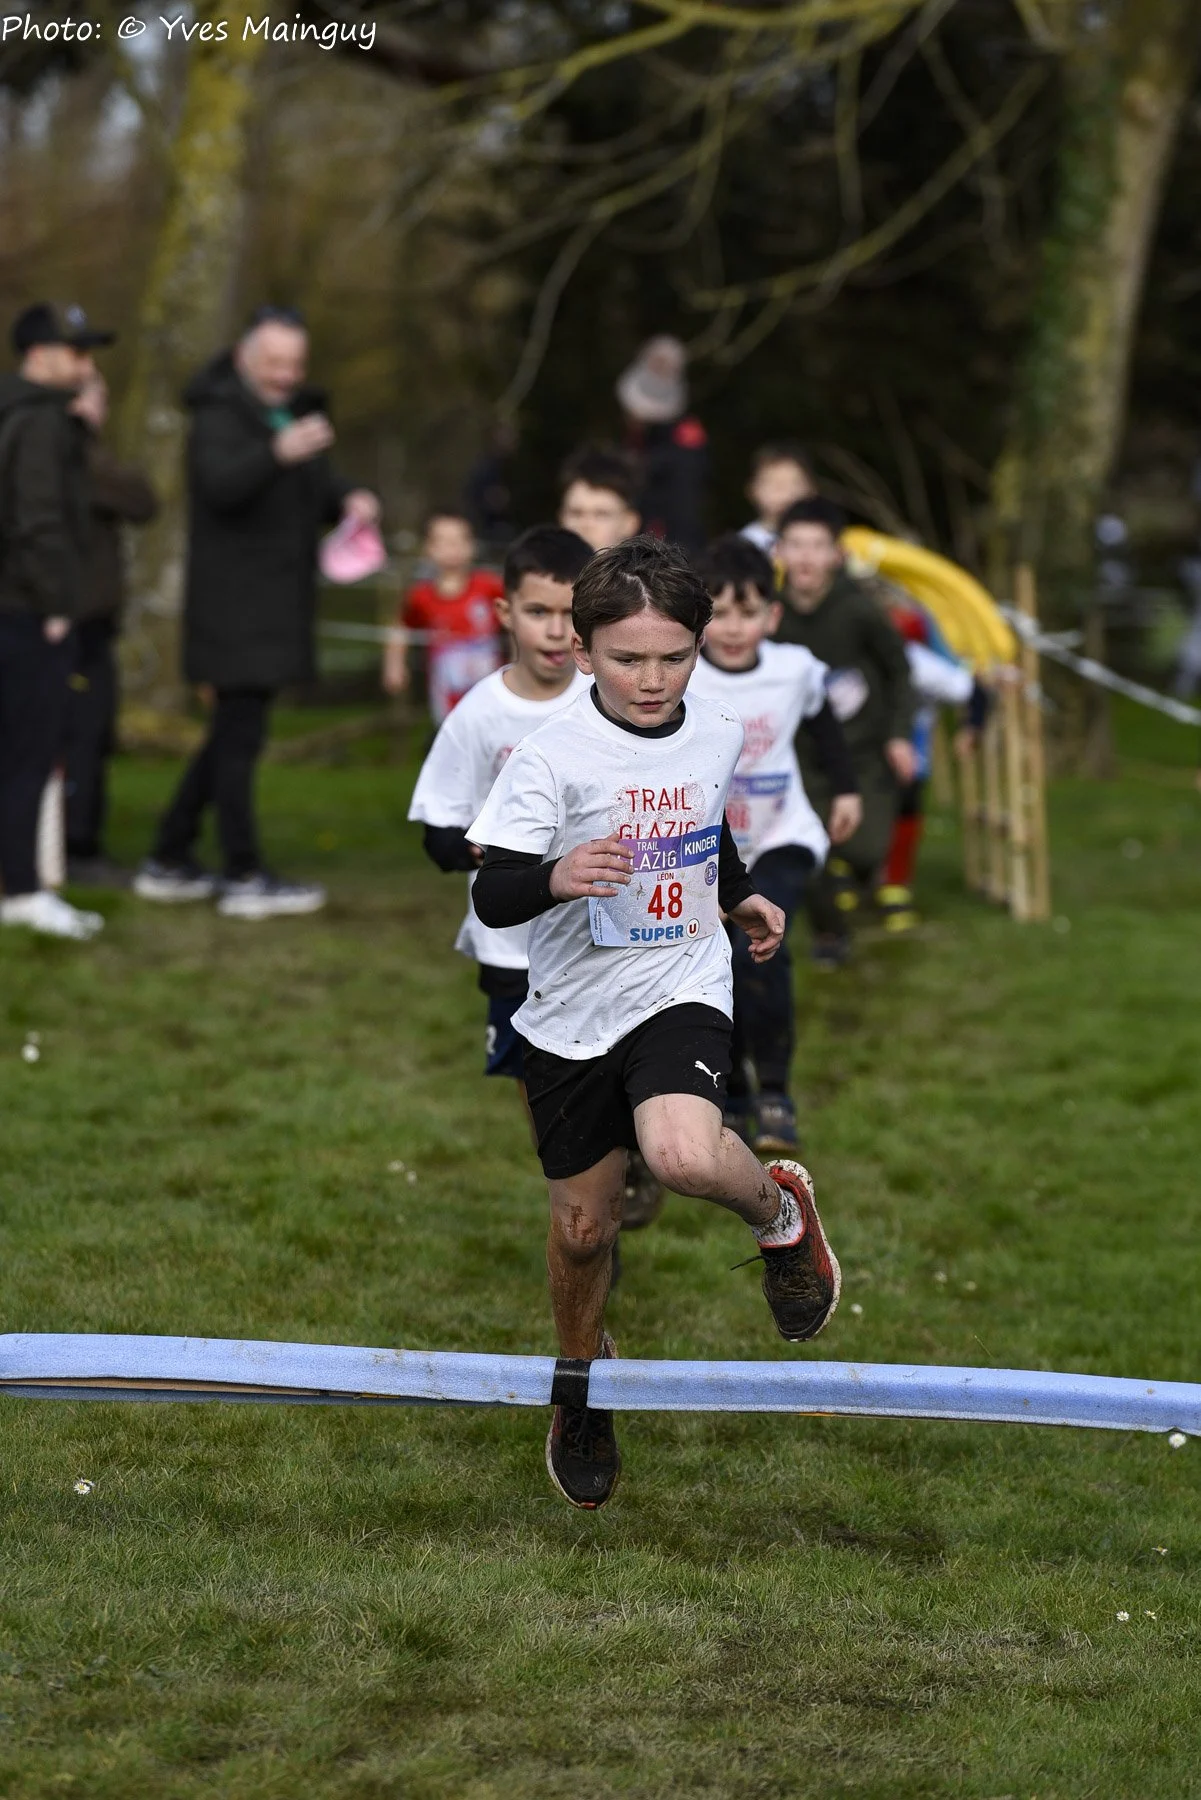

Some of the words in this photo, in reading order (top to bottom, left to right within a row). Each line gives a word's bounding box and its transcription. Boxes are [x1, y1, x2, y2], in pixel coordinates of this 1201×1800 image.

[625, 787, 692, 812] TRAIL
[637, 841, 659, 851] TRAIL
[684, 835, 717, 856] KINDER
[647, 882, 683, 920] 48
[629, 924, 684, 942] SUPER
